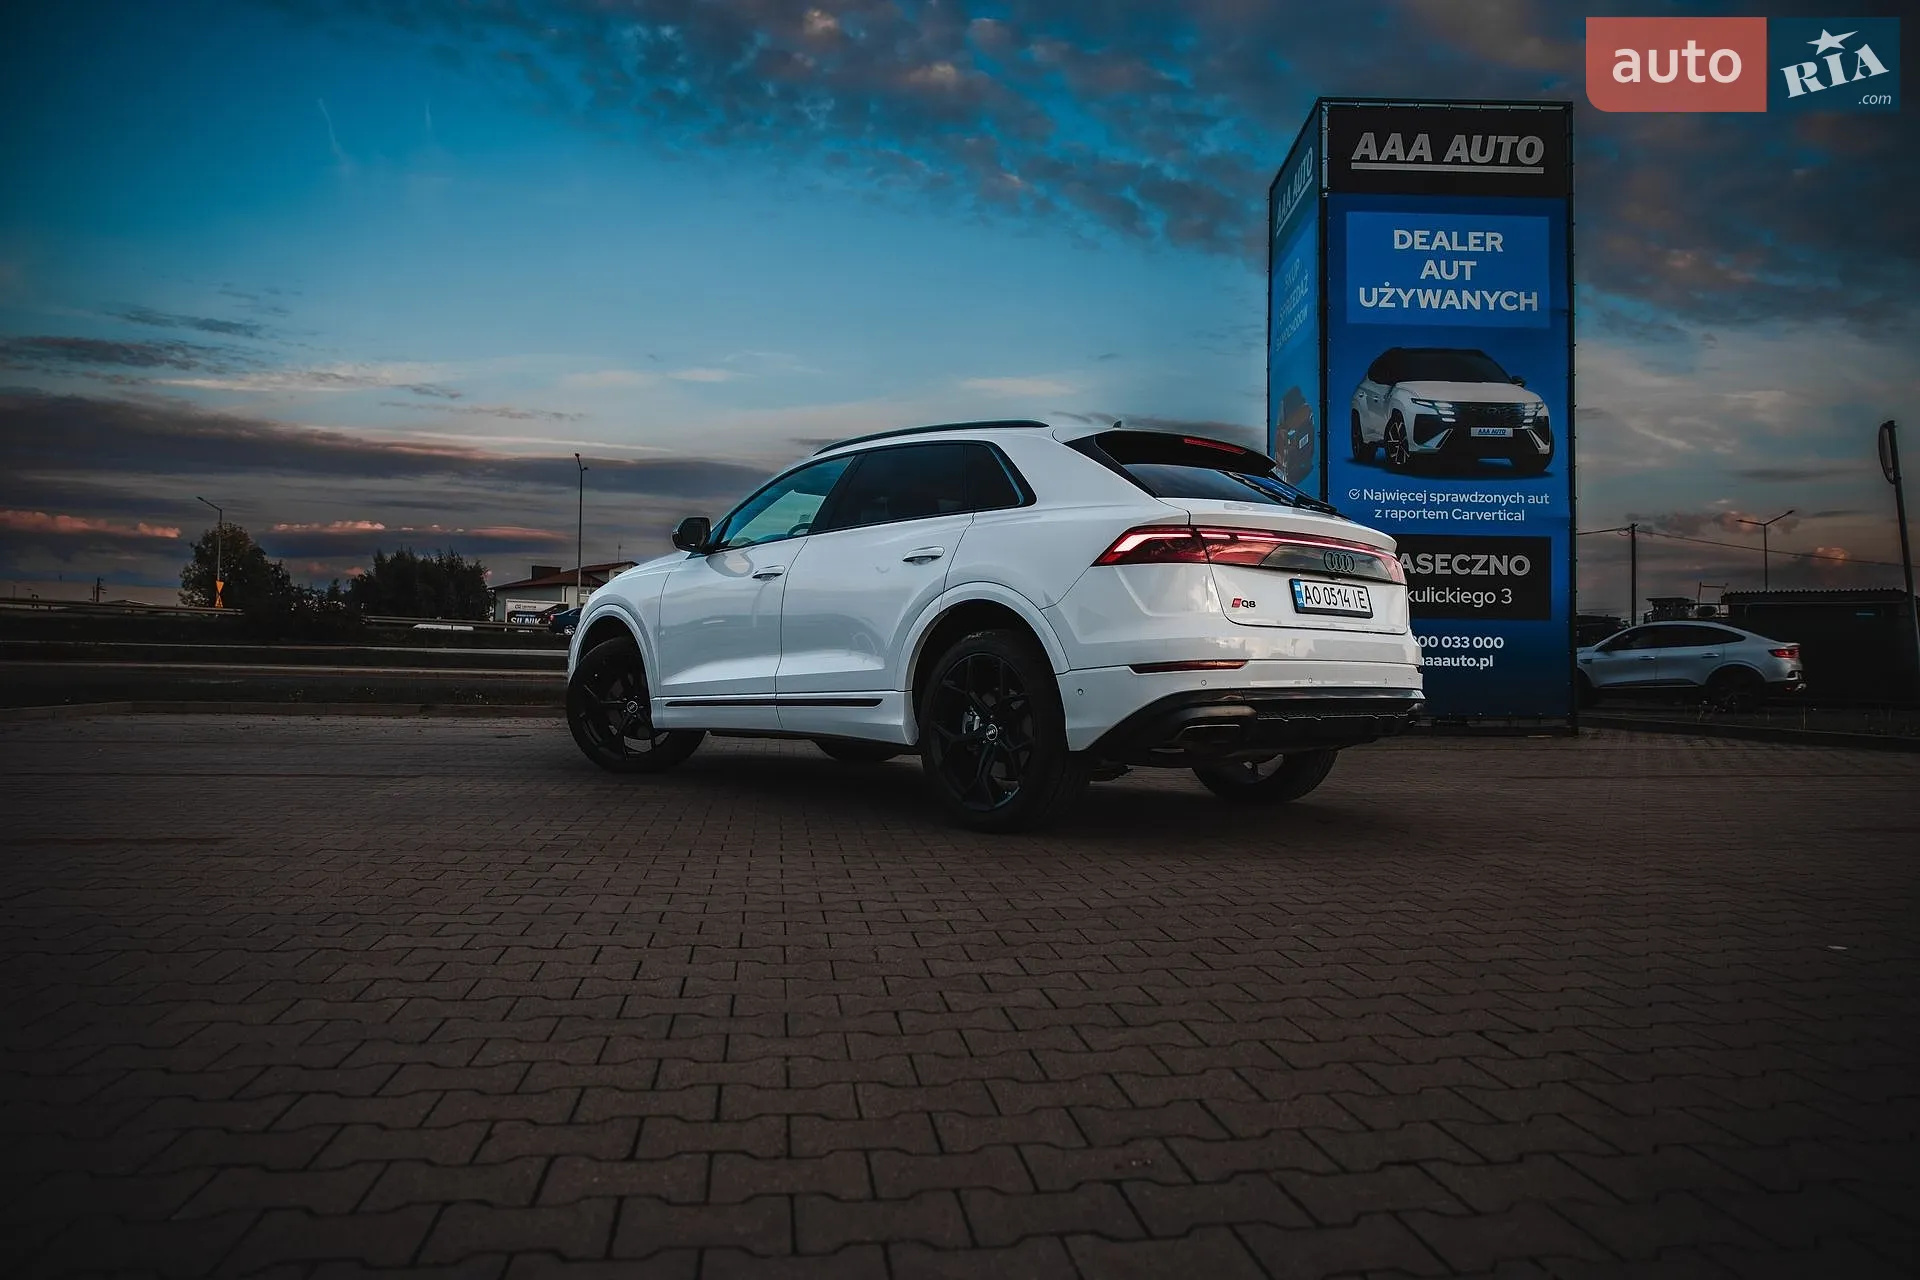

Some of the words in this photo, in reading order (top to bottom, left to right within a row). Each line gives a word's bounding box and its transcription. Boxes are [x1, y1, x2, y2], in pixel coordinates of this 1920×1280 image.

[1352, 132, 1433, 162] AAA
[1443, 134, 1545, 165] AUTO
[1276, 183, 1291, 229] AAA
[1292, 147, 1313, 204] AUTO
[1393, 230, 1504, 253] DEALER
[1419, 259, 1477, 281] AUT
[1359, 282, 1538, 312] UŻYWANYCH
[1363, 488, 1427, 504] Najwięcej
[1429, 491, 1525, 506] sprawdzonych
[1527, 493, 1550, 505] aut
[1374, 510, 1382, 518] z
[1385, 508, 1449, 522] raportem
[1451, 508, 1525, 521] Carvertical
[1304, 585, 1321, 605] AO
[1324, 587, 1351, 607] 0514
[1353, 590, 1367, 609] IE
[1501, 588, 1513, 605] 3
[1413, 635, 1439, 648] 00
[1441, 636, 1470, 649] 033
[1472, 636, 1505, 649] 000
